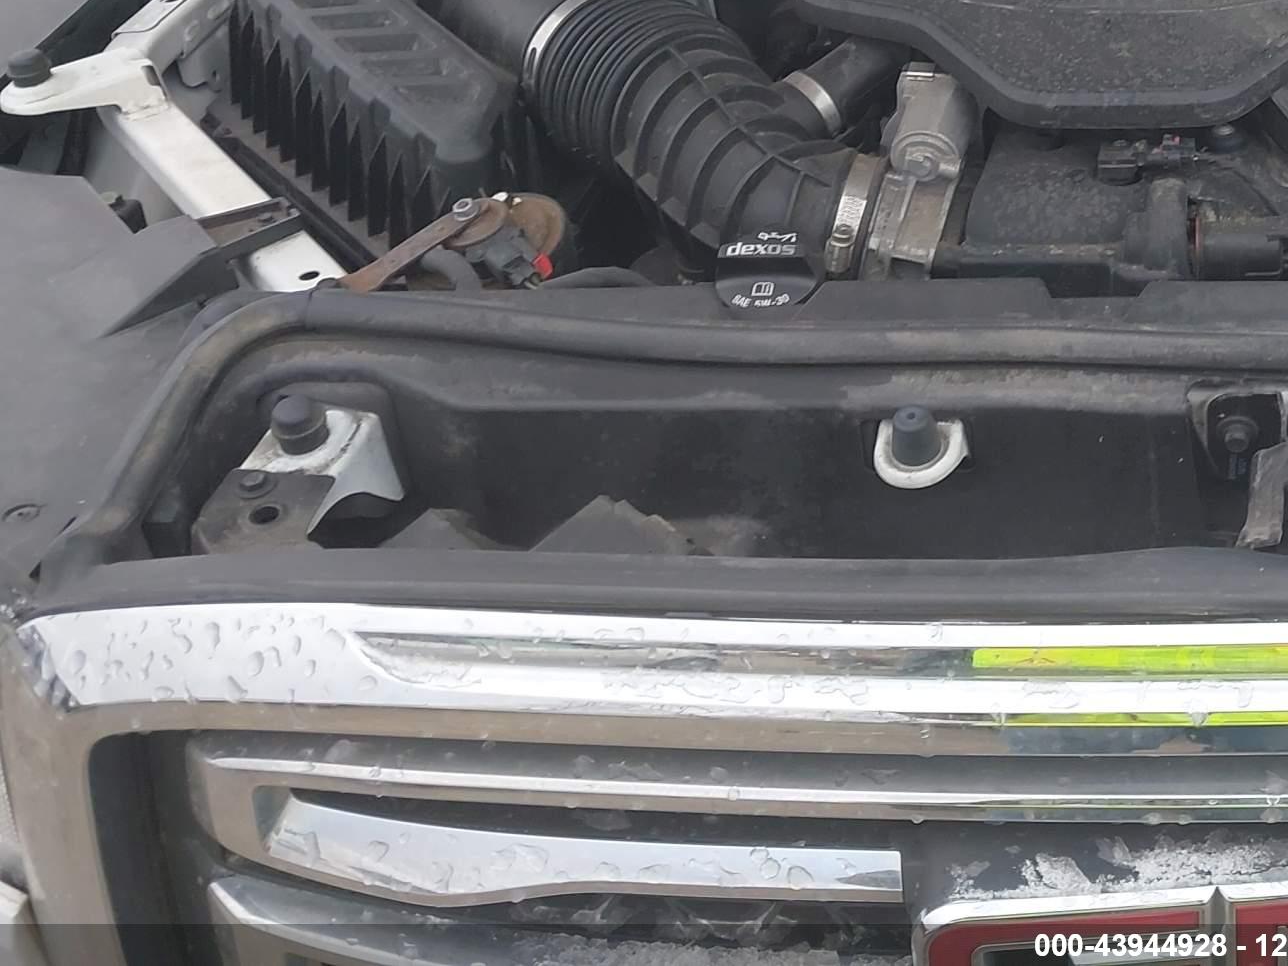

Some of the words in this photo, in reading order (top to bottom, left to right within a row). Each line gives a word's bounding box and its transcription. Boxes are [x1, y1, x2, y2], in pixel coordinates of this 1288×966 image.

[726, 242, 797, 256] dexos
[731, 294, 752, 308] SAE
[754, 293, 790, 307] 5W-30
